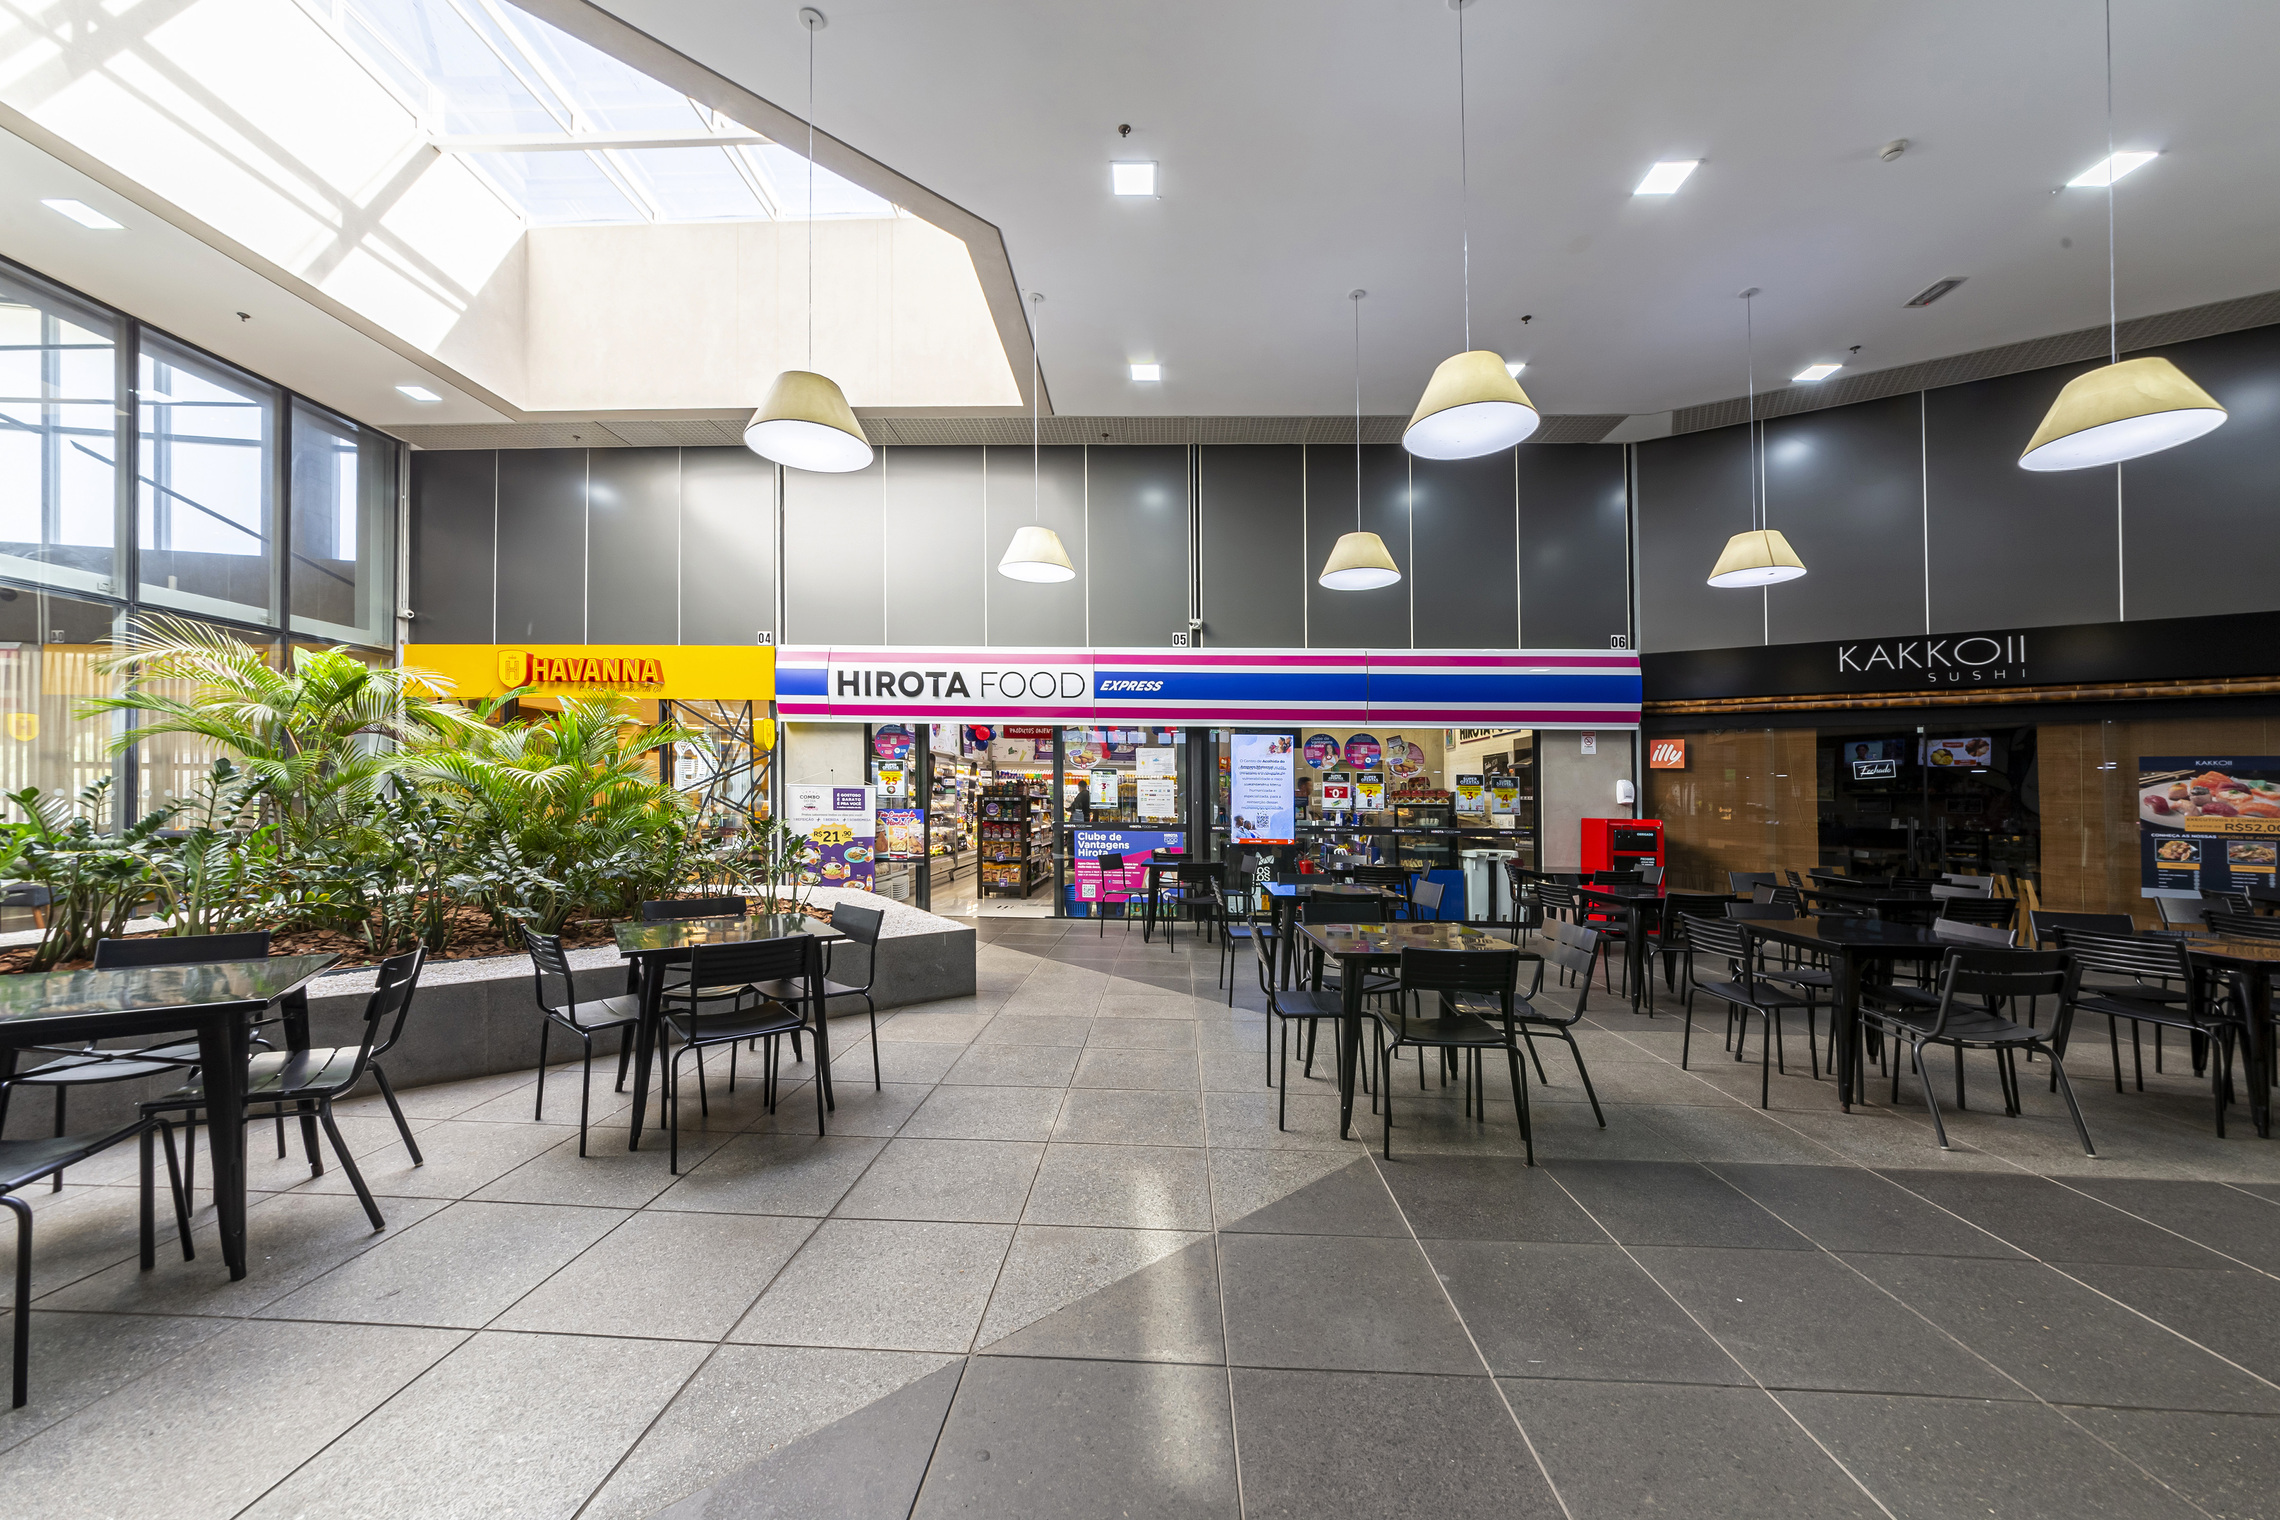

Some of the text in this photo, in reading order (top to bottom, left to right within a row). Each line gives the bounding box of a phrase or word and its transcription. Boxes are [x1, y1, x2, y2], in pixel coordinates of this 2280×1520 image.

[758, 632, 771, 644] 04
[1173, 634, 1186, 646] 05
[1611, 636, 1625, 648] 06
[532, 657, 662, 683] HAVANNA
[1927, 668, 2027, 683] SUSHI
[837, 669, 1164, 700] HIROTA FOOD EXPRESS
[1008, 727, 1035, 736] PRODUTOS
[1652, 743, 1683, 766] illy
[1857, 763, 1892, 778] Fechado
[1101, 782, 1107, 790] 3
[1331, 788, 1340, 798] 0
[1366, 789, 1373, 798] 2
[1466, 791, 1474, 801] 3
[1501, 793, 1509, 803] 4
[822, 830, 841, 842] 21
[1077, 832, 1122, 841] Clube de
[1077, 841, 1130, 851] Vantagens
[1077, 848, 1109, 857] Hirota
